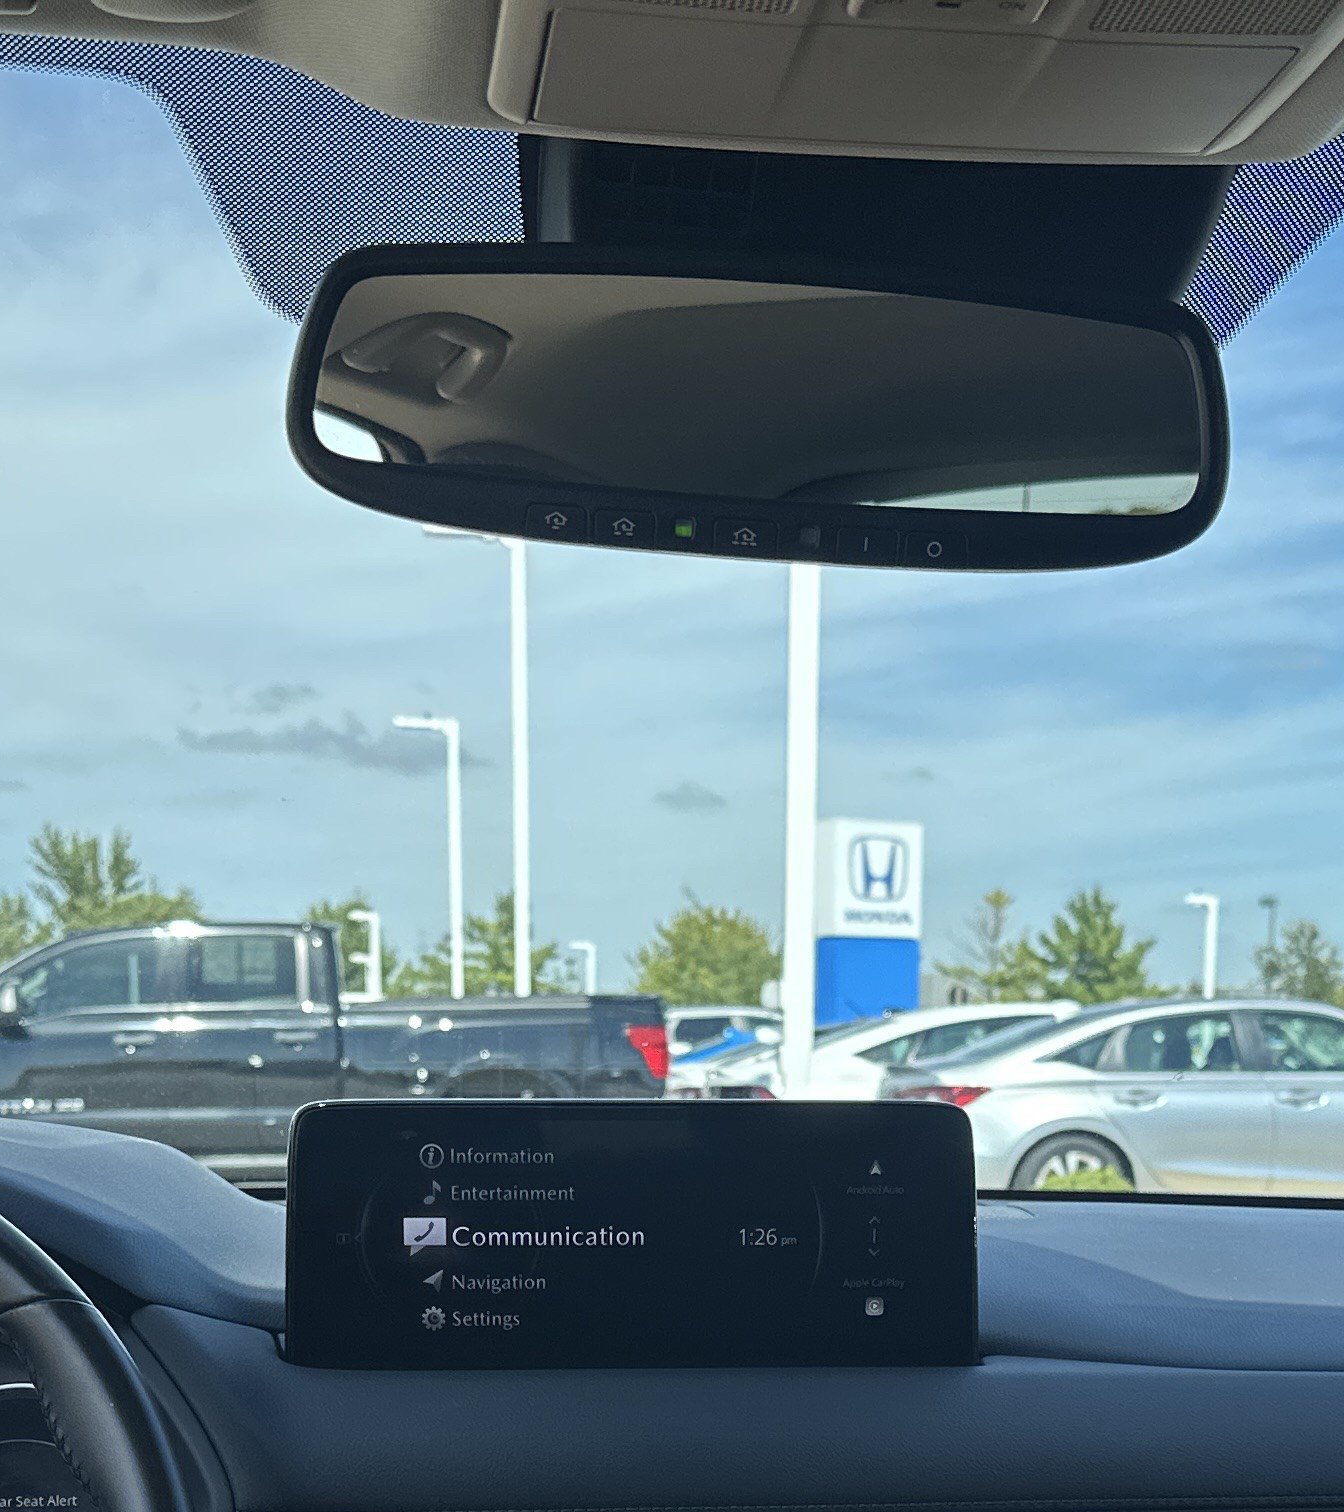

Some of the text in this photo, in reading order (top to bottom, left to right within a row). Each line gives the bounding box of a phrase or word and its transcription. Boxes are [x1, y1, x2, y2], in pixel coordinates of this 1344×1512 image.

[450, 1148, 555, 1164] Information
[451, 1184, 576, 1201] Entertainment
[452, 1225, 645, 1247] Communication
[739, 1228, 797, 1247] 1:26 pm
[451, 1274, 546, 1294] Navigation
[452, 1311, 520, 1331] Settings
[15, 1496, 44, 1508] Seat
[46, 1495, 78, 1507] Alert
